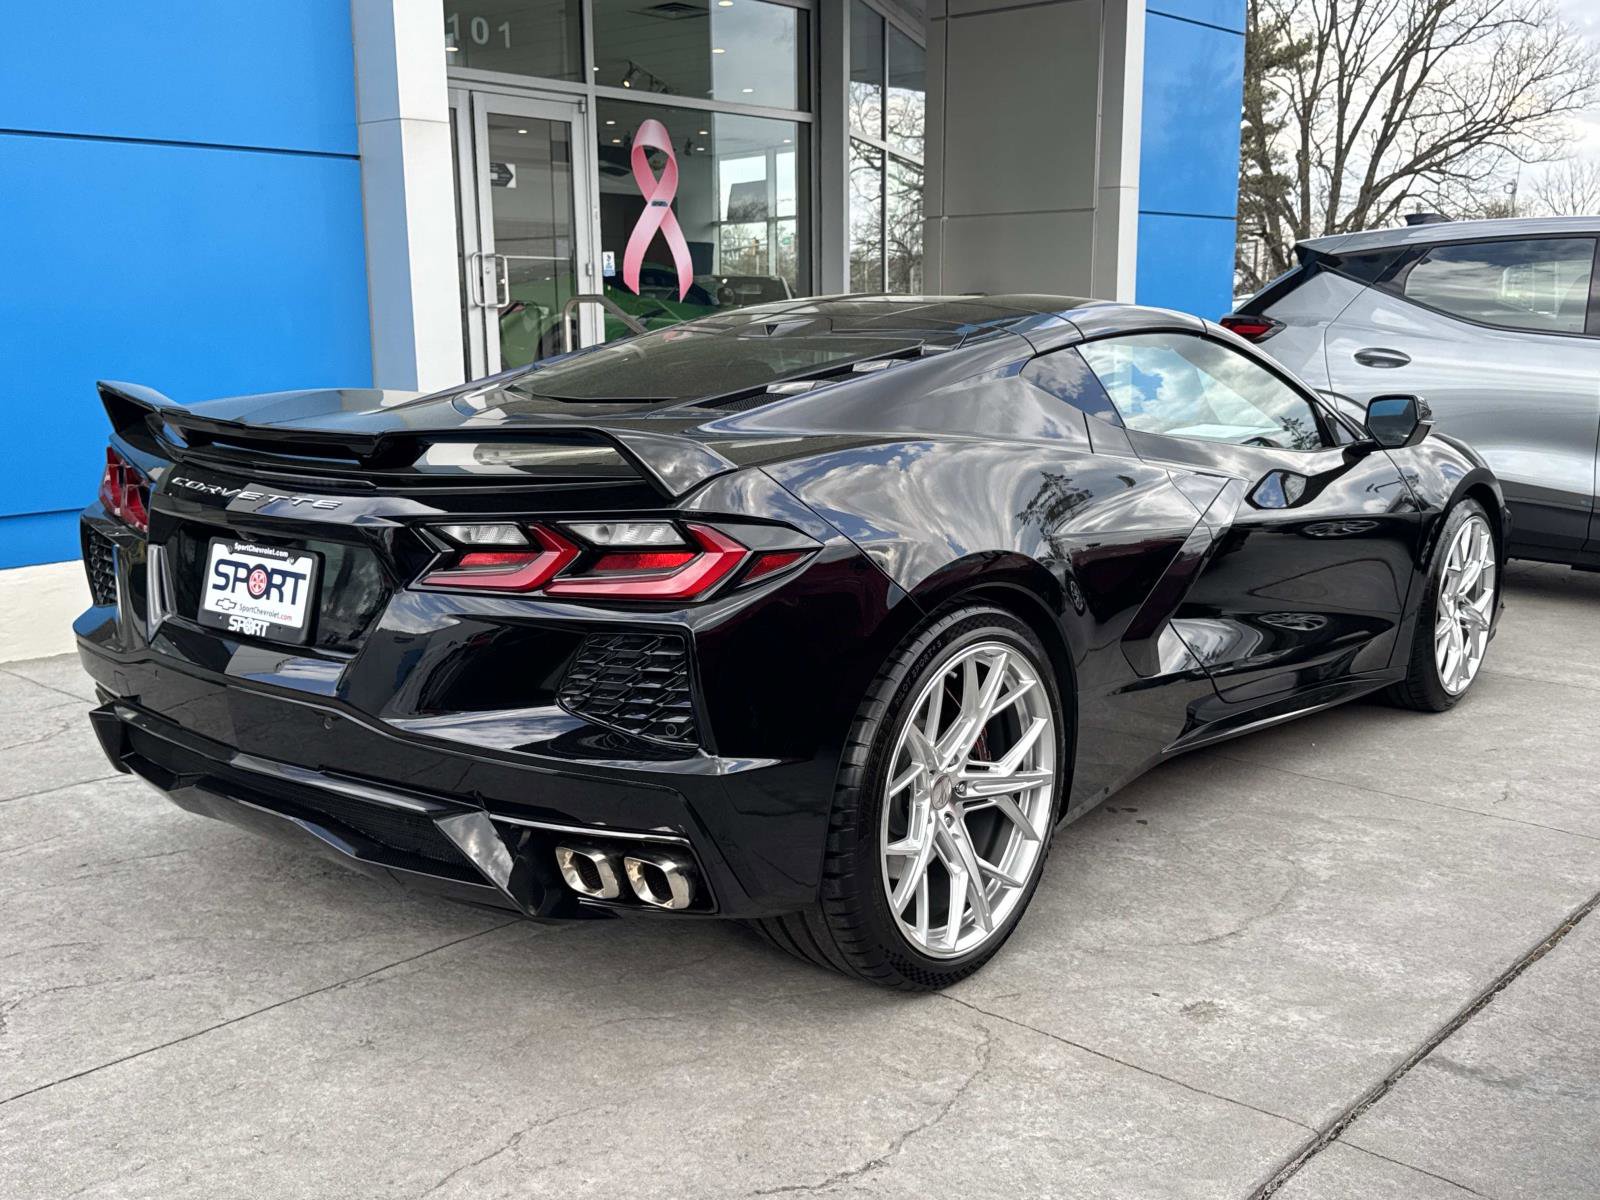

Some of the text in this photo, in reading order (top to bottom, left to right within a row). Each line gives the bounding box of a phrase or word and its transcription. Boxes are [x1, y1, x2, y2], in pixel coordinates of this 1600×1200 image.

[171, 476, 343, 510] CORVETTE
[234, 542, 289, 557] SportChevrolet.com
[212, 558, 307, 606] SPORT
[239, 603, 293, 621] SportChevrolet.com
[227, 615, 270, 637] SPORT
